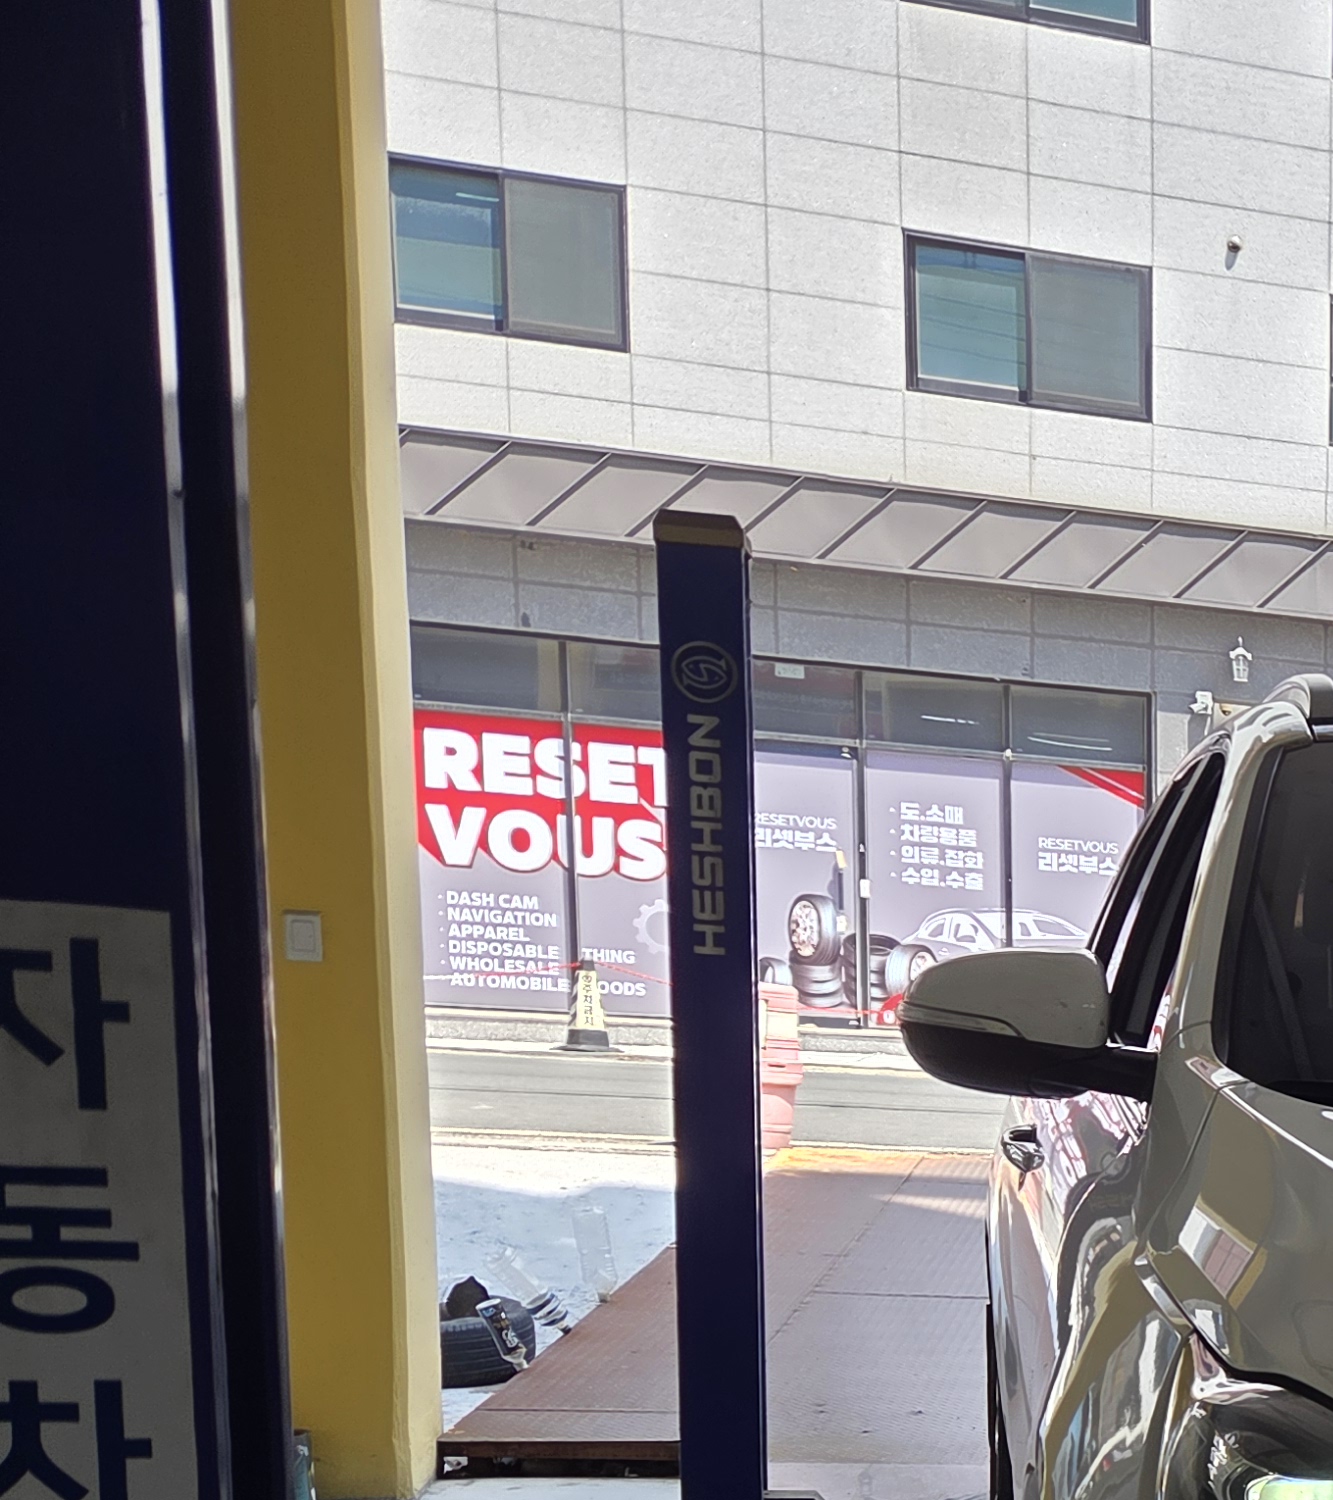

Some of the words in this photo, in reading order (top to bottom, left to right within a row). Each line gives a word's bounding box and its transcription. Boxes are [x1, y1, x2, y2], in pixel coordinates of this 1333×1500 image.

[423, 727, 668, 806] RESET
[424, 803, 668, 882] VOUS
[687, 714, 726, 956] HESHBON
[754, 827, 838, 852] 리셋부스
[900, 823, 978, 847] 차량용품
[1038, 836, 1119, 854] RESETVOUS
[1038, 851, 1120, 876] 리셋부스
[446, 891, 494, 907] DASH
[498, 894, 539, 910] CAM
[447, 907, 557, 927] NAVIGATION
[448, 924, 530, 942] APPAREL
[449, 940, 560, 960] DISPOSABLE
[449, 956, 560, 976] WHOLESALE
[451, 972, 571, 993] AUTOMOBILE
[598, 981, 647, 997] OODS
